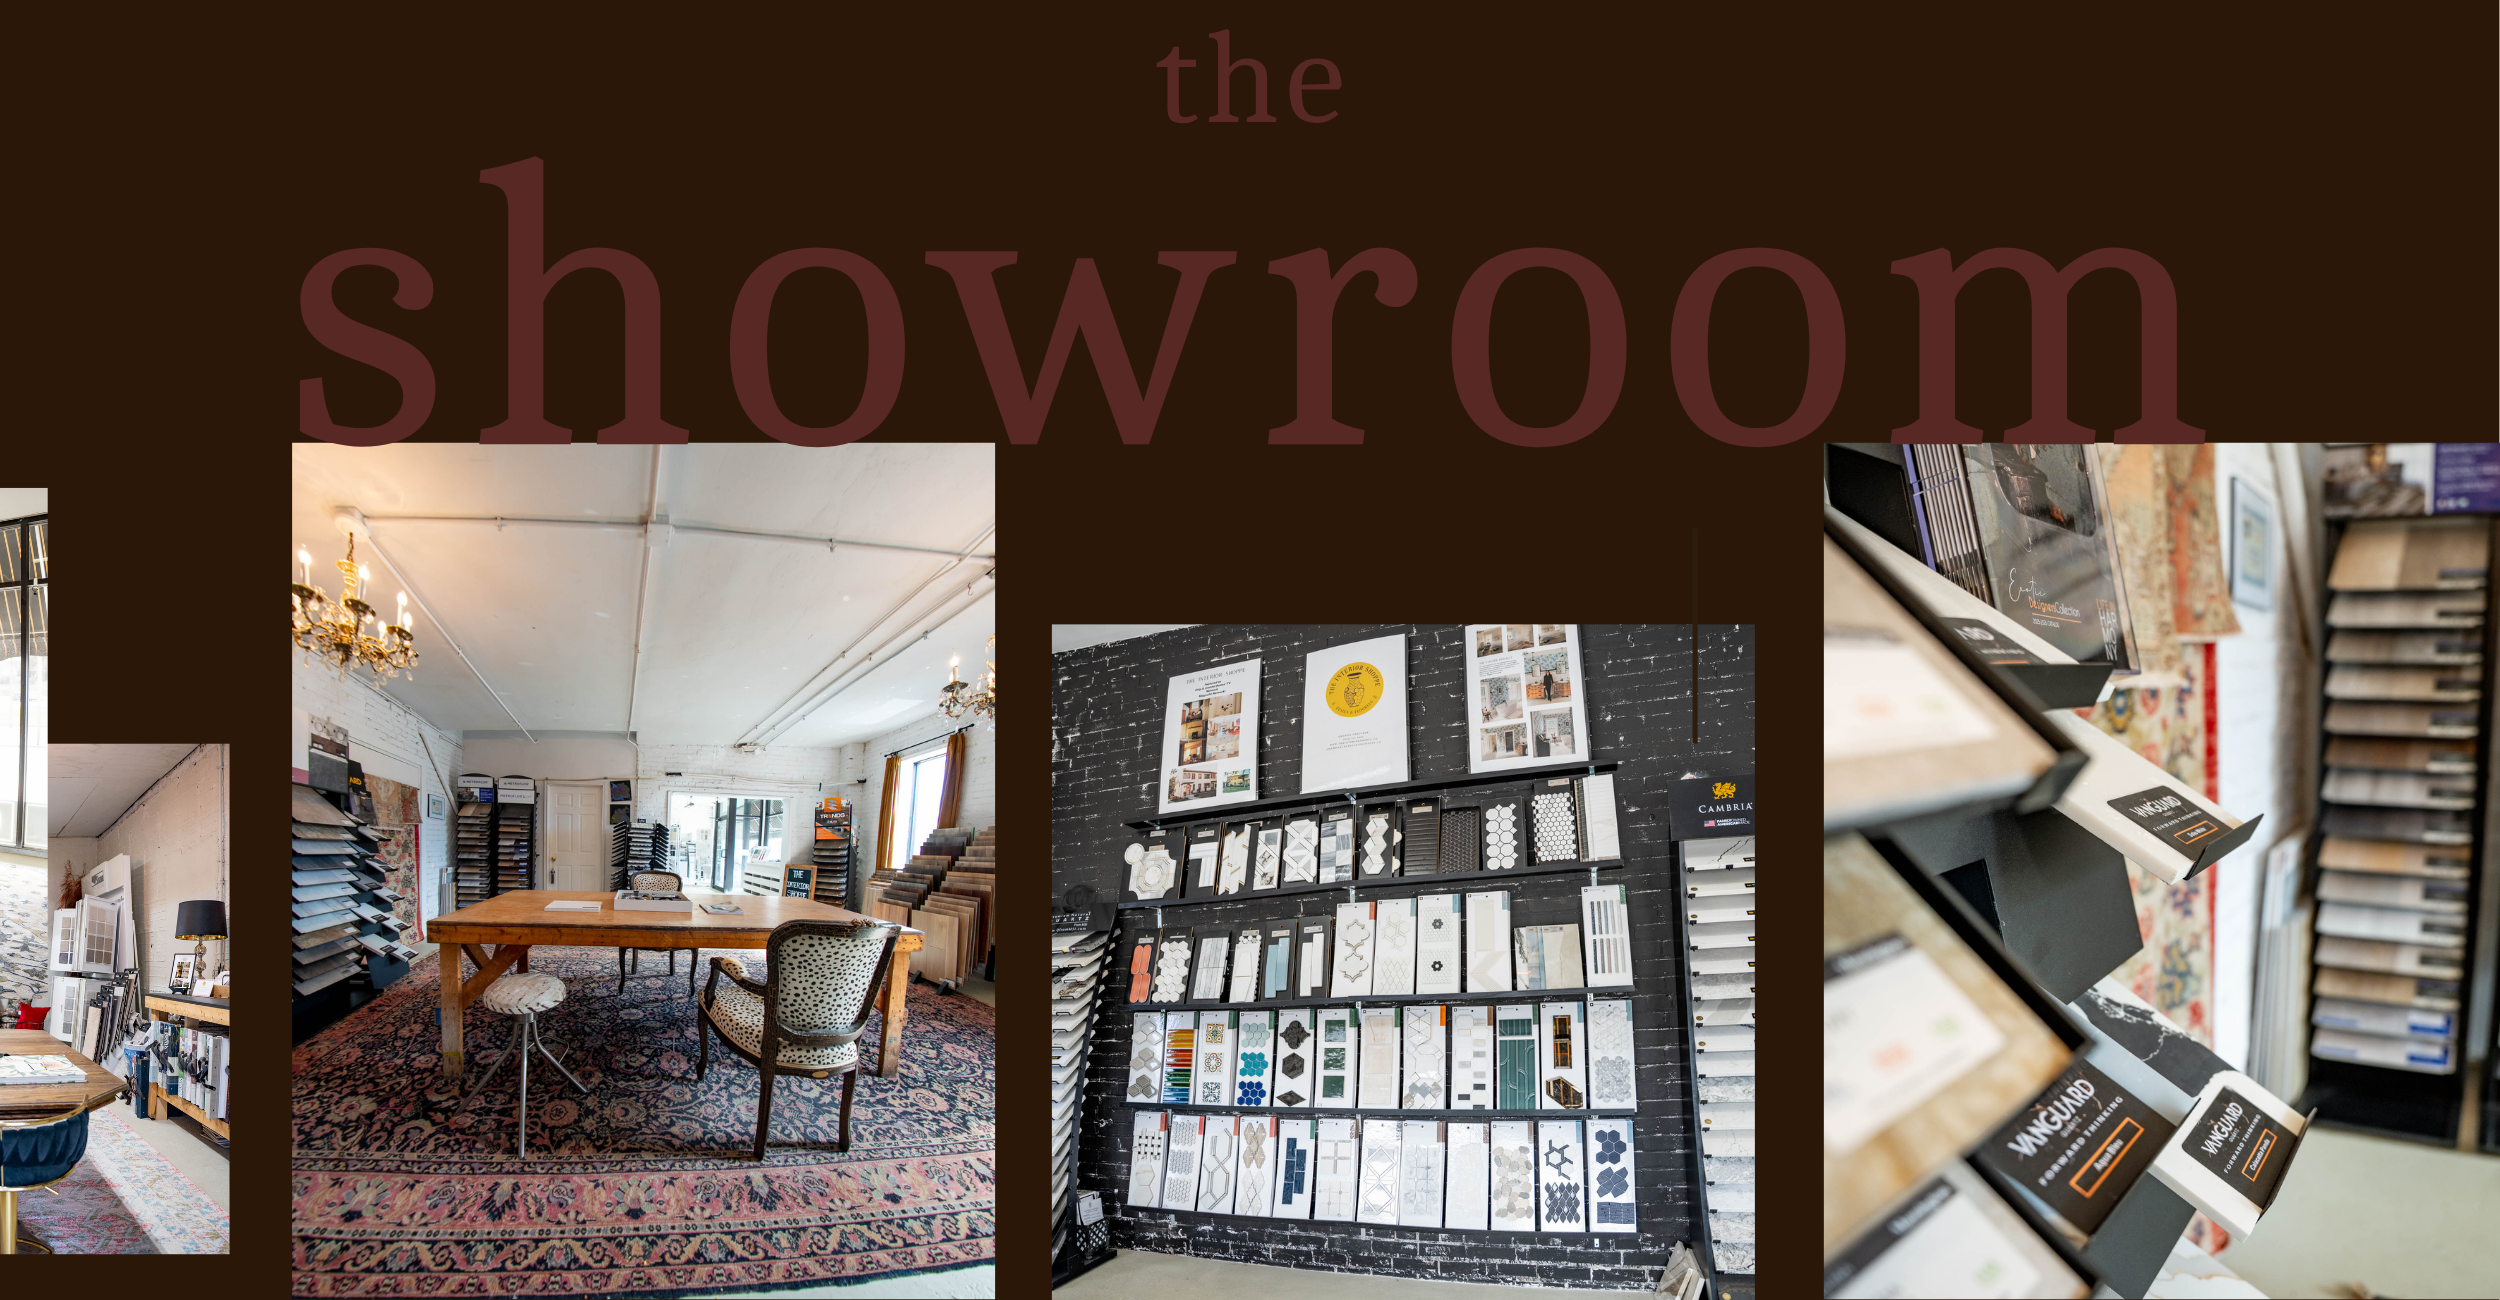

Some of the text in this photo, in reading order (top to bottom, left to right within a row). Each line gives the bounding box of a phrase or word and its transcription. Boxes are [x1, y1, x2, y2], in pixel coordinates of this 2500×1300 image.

[1335, 665, 1364, 681] INTERIOR
[1698, 802, 1753, 814] CAMBRIA
[2129, 795, 2182, 818] VANGUARD
[2153, 820, 2180, 831] FORWARD
[793, 870, 804, 878] THE
[2007, 1079, 2095, 1157] VANGUARD
[2201, 1102, 2243, 1155] VANGUARD
[2038, 1096, 2123, 1187] FORWARD THINKING
[2223, 1113, 2261, 1174] FORWARD THINKING
